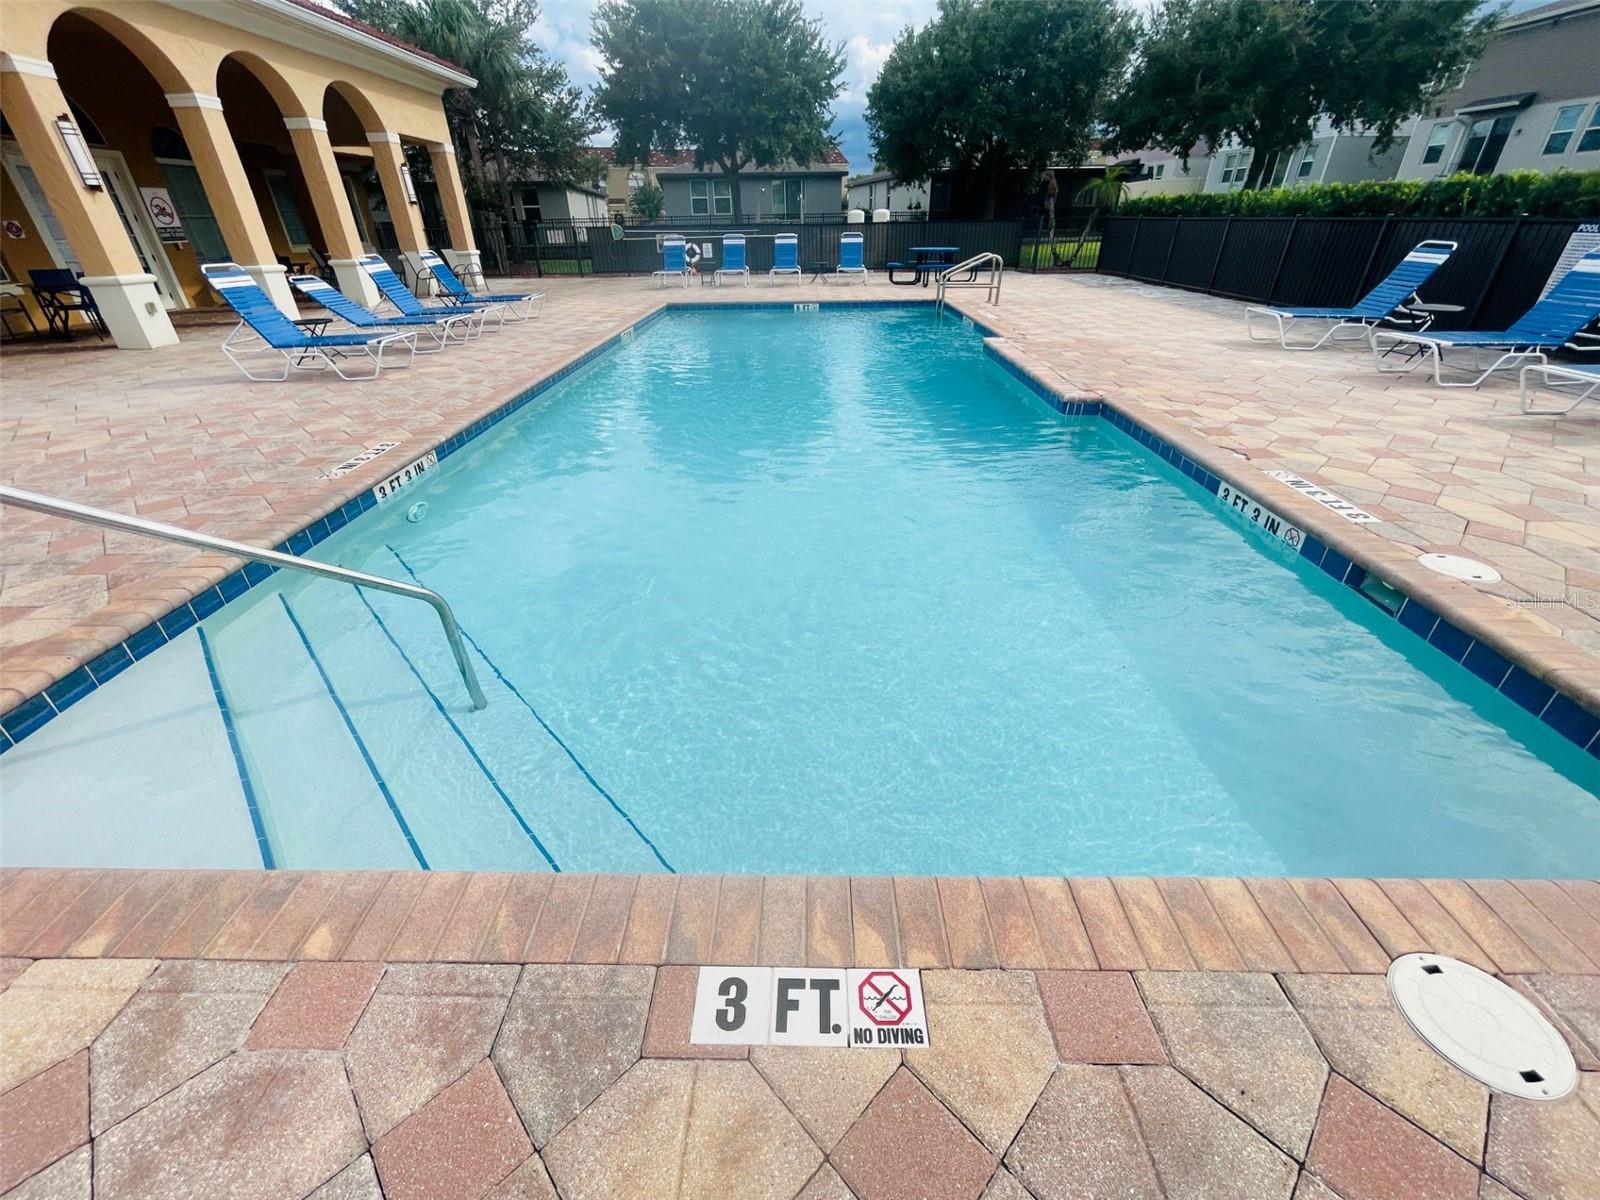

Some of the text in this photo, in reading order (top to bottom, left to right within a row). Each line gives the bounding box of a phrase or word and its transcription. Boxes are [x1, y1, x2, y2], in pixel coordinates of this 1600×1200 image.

[1577, 223, 1600, 232] POOL
[378, 461, 425, 499] 3 FT 3 IN
[1222, 487, 1281, 536] 3 FT 3 IN
[715, 976, 842, 1035] 3 FT.
[853, 1027, 924, 1044] NO DIVING
